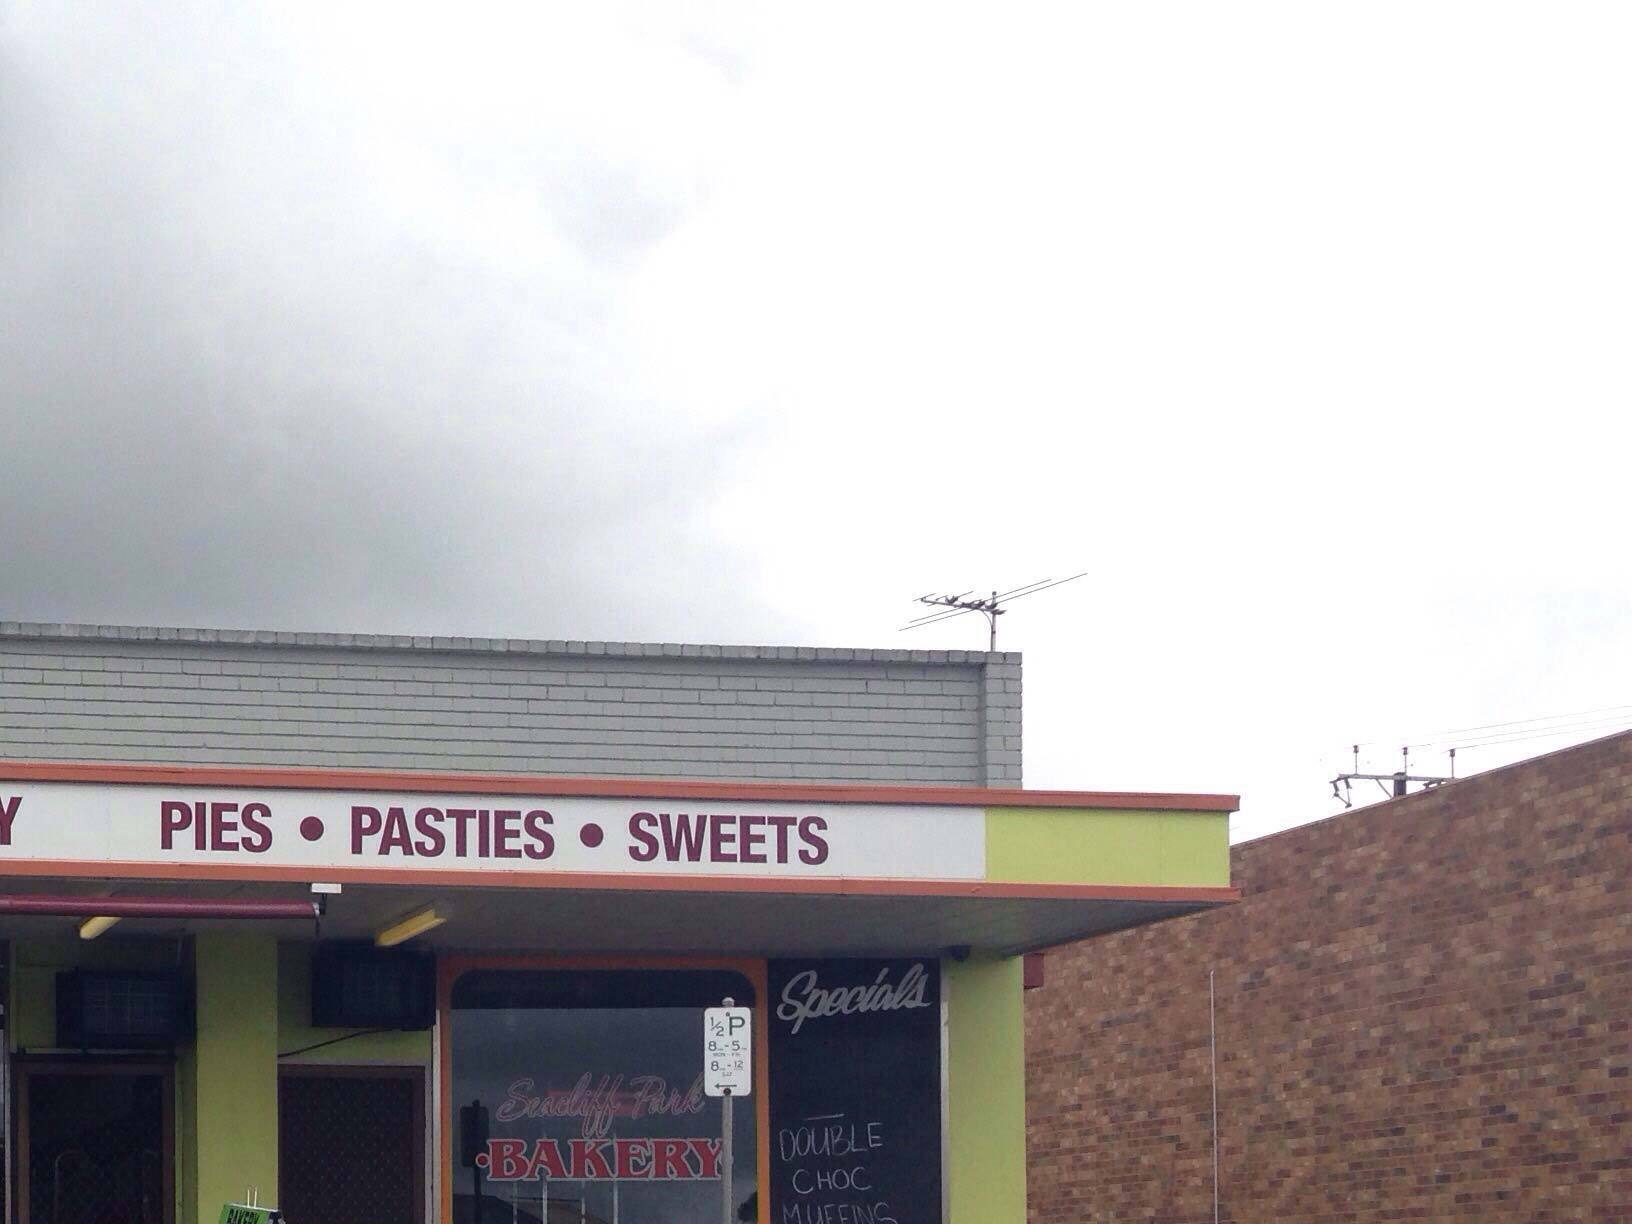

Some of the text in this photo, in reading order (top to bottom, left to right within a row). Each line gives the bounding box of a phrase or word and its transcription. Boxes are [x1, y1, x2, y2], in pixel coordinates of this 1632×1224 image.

[160, 801, 829, 866] PIES PASTIES SWEETS
[776, 963, 934, 1034] Specials
[496, 1072, 706, 1139] Seacliff Park
[487, 1138, 734, 1181] BAKERY
[779, 1122, 883, 1162] DOUBLE
[792, 1167, 872, 1194] CHOC
